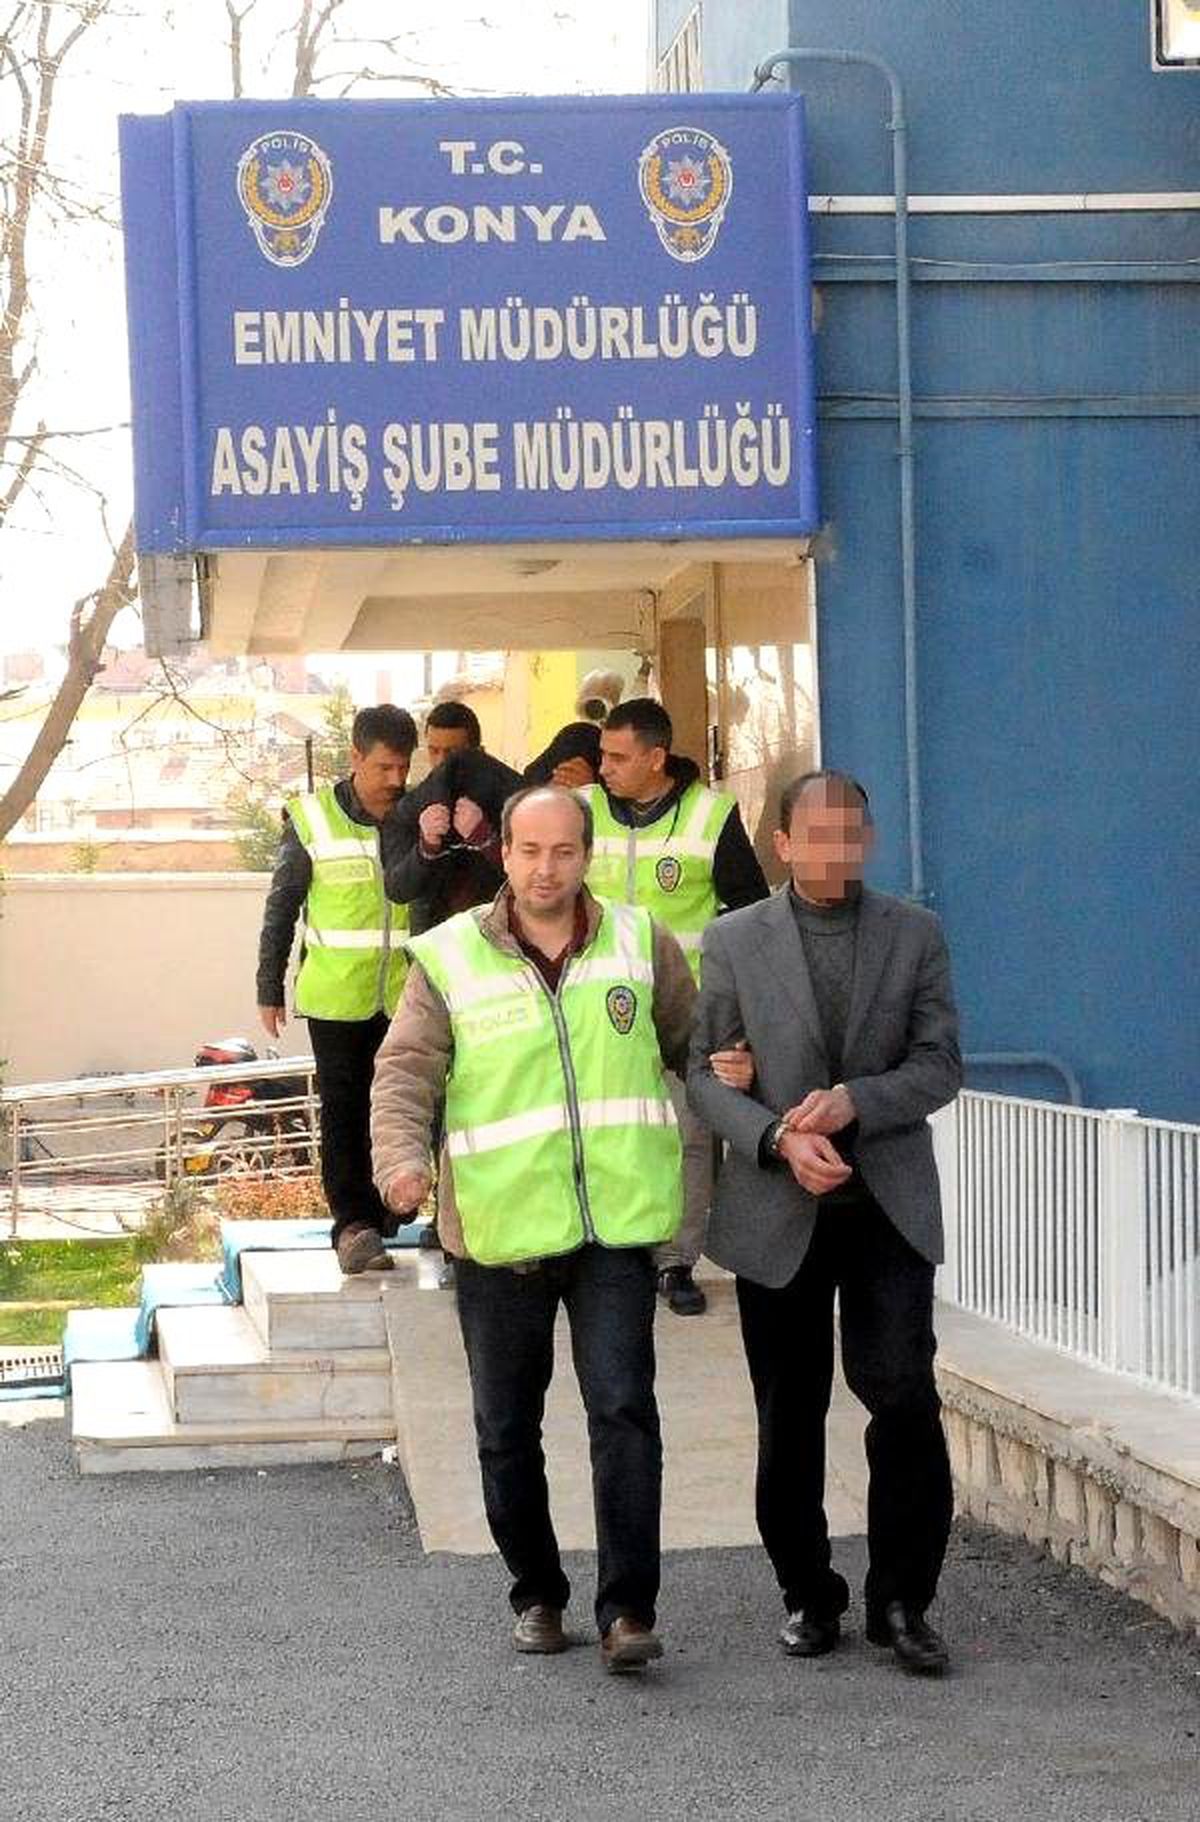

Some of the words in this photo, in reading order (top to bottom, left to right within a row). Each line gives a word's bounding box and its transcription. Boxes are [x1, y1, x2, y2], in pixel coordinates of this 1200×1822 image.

[439, 141, 543, 175] T.C.
[379, 205, 607, 244] KONYA
[234, 297, 445, 365] EMNİYET
[460, 292, 757, 362] MÜDÜRLÜĞÜ
[211, 408, 369, 511] ASAYİŞ
[382, 422, 501, 511] ŞUBE
[513, 401, 791, 491] MÜDÜRLÜĞÜ
